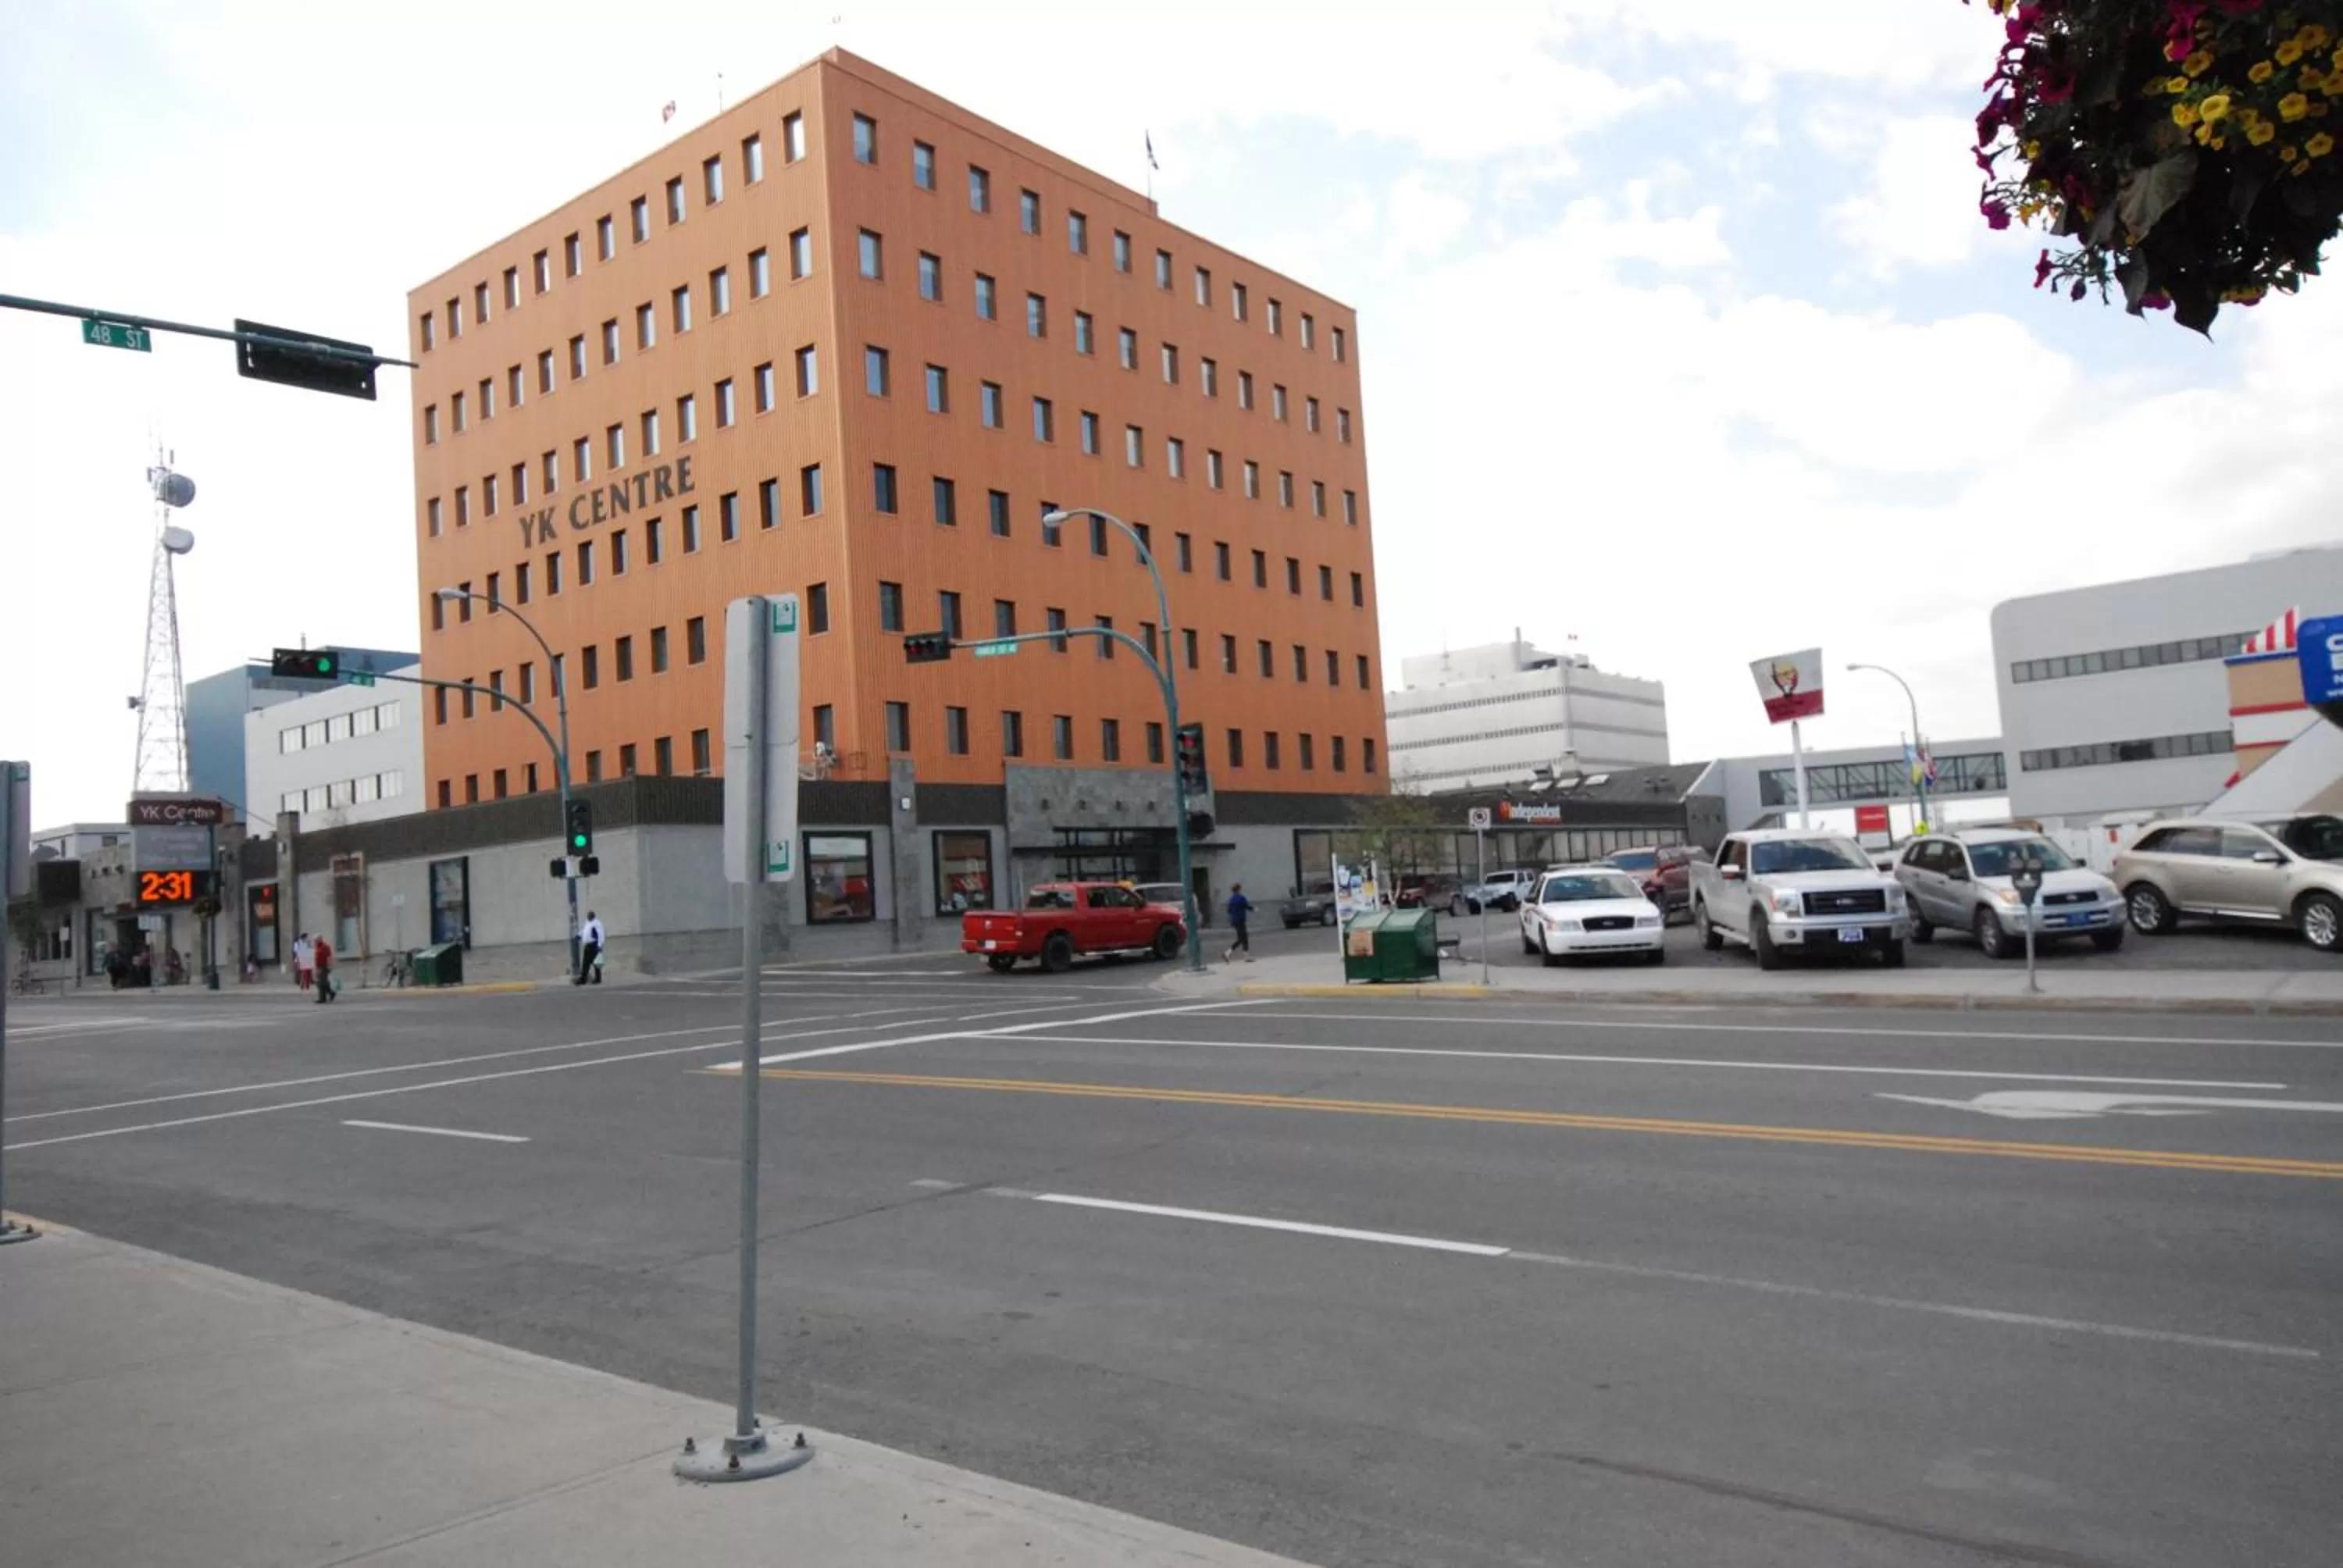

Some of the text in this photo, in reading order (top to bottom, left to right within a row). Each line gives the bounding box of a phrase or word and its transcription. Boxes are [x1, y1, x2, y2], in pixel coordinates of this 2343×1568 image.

[90, 324, 143, 349] 48 ST
[519, 455, 696, 549] YK CENTRE
[140, 805, 160, 820] YK
[141, 871, 192, 900] 2:31
